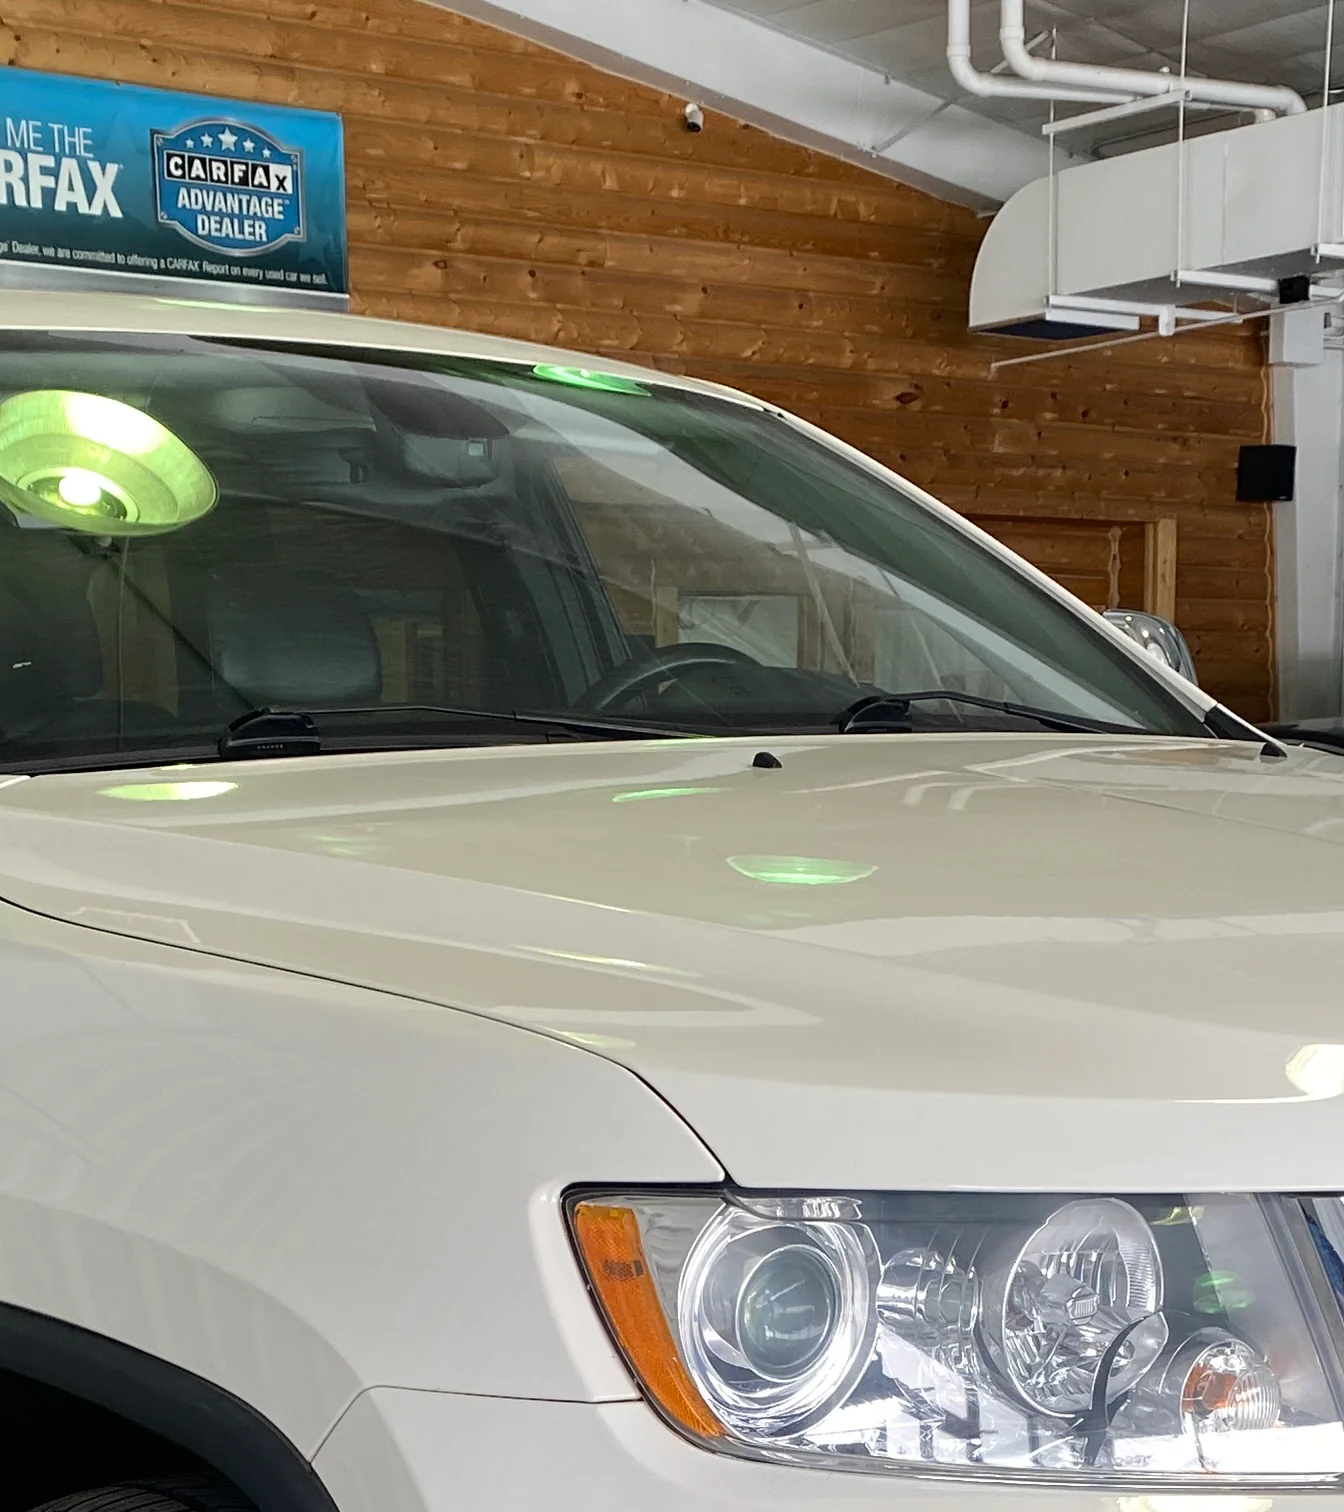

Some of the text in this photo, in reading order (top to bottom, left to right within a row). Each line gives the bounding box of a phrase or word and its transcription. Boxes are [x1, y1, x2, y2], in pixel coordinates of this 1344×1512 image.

[6, 117, 43, 151] ME
[47, 122, 93, 157] THE
[167, 155, 289, 193] CARFAX
[197, 214, 267, 242] DEALER
[12, 241, 42, 256] Dealer,
[43, 245, 55, 257] we
[57, 247, 71, 258] are
[72, 249, 116, 263] committed
[117, 253, 126, 265] to
[127, 256, 158, 270] offering
[160, 258, 166, 269] a
[203, 260, 230, 275] Report
[231, 265, 241, 275] on
[243, 267, 264, 280] every
[265, 268, 285, 280] used
[286, 271, 298, 281] car
[300, 272, 312, 283] we
